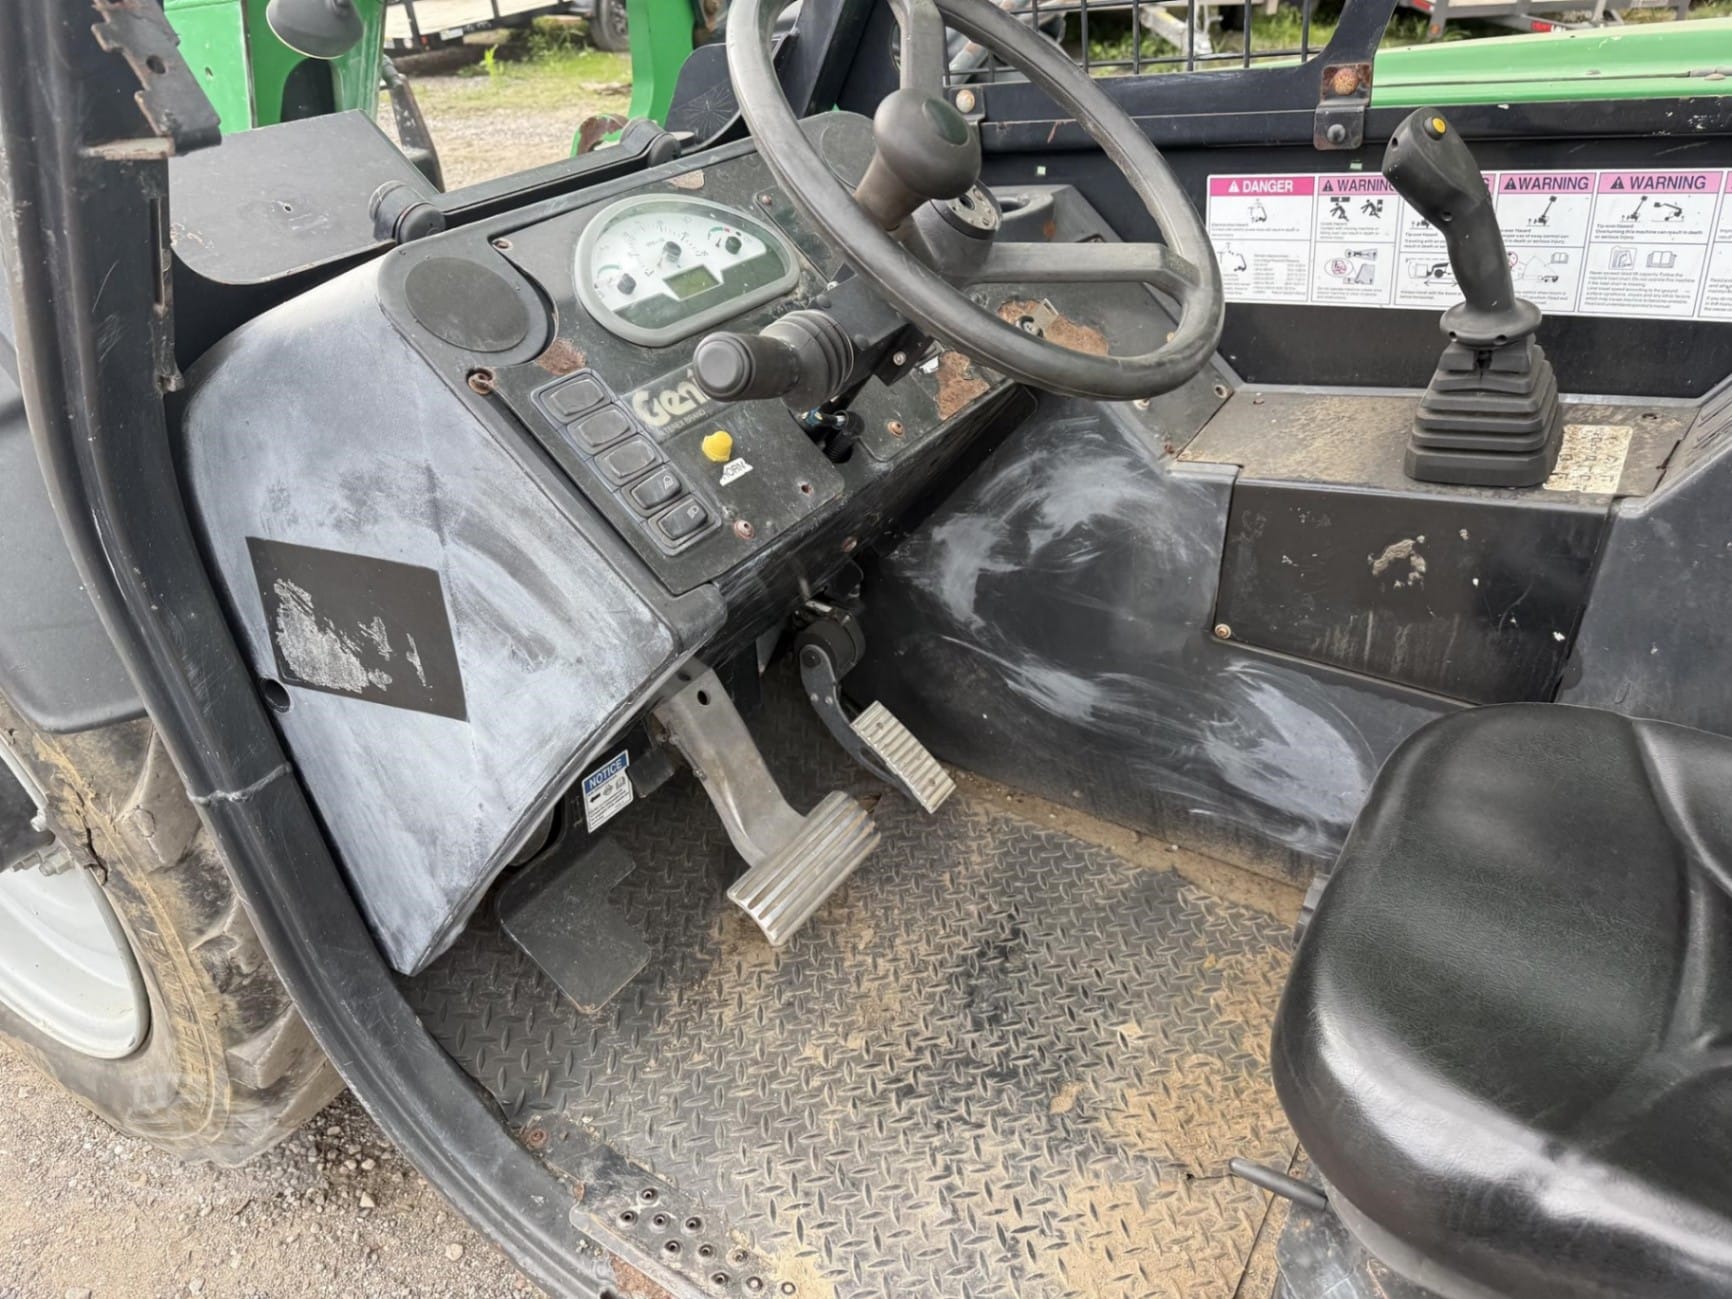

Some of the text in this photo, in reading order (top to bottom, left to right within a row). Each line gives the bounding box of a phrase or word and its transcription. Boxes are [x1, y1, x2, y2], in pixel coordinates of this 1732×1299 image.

[1242, 180, 1294, 193] DANGER
[1518, 176, 1590, 190] WARNING
[1630, 175, 1707, 190] WARNING
[588, 758, 622, 790] NOTICE
